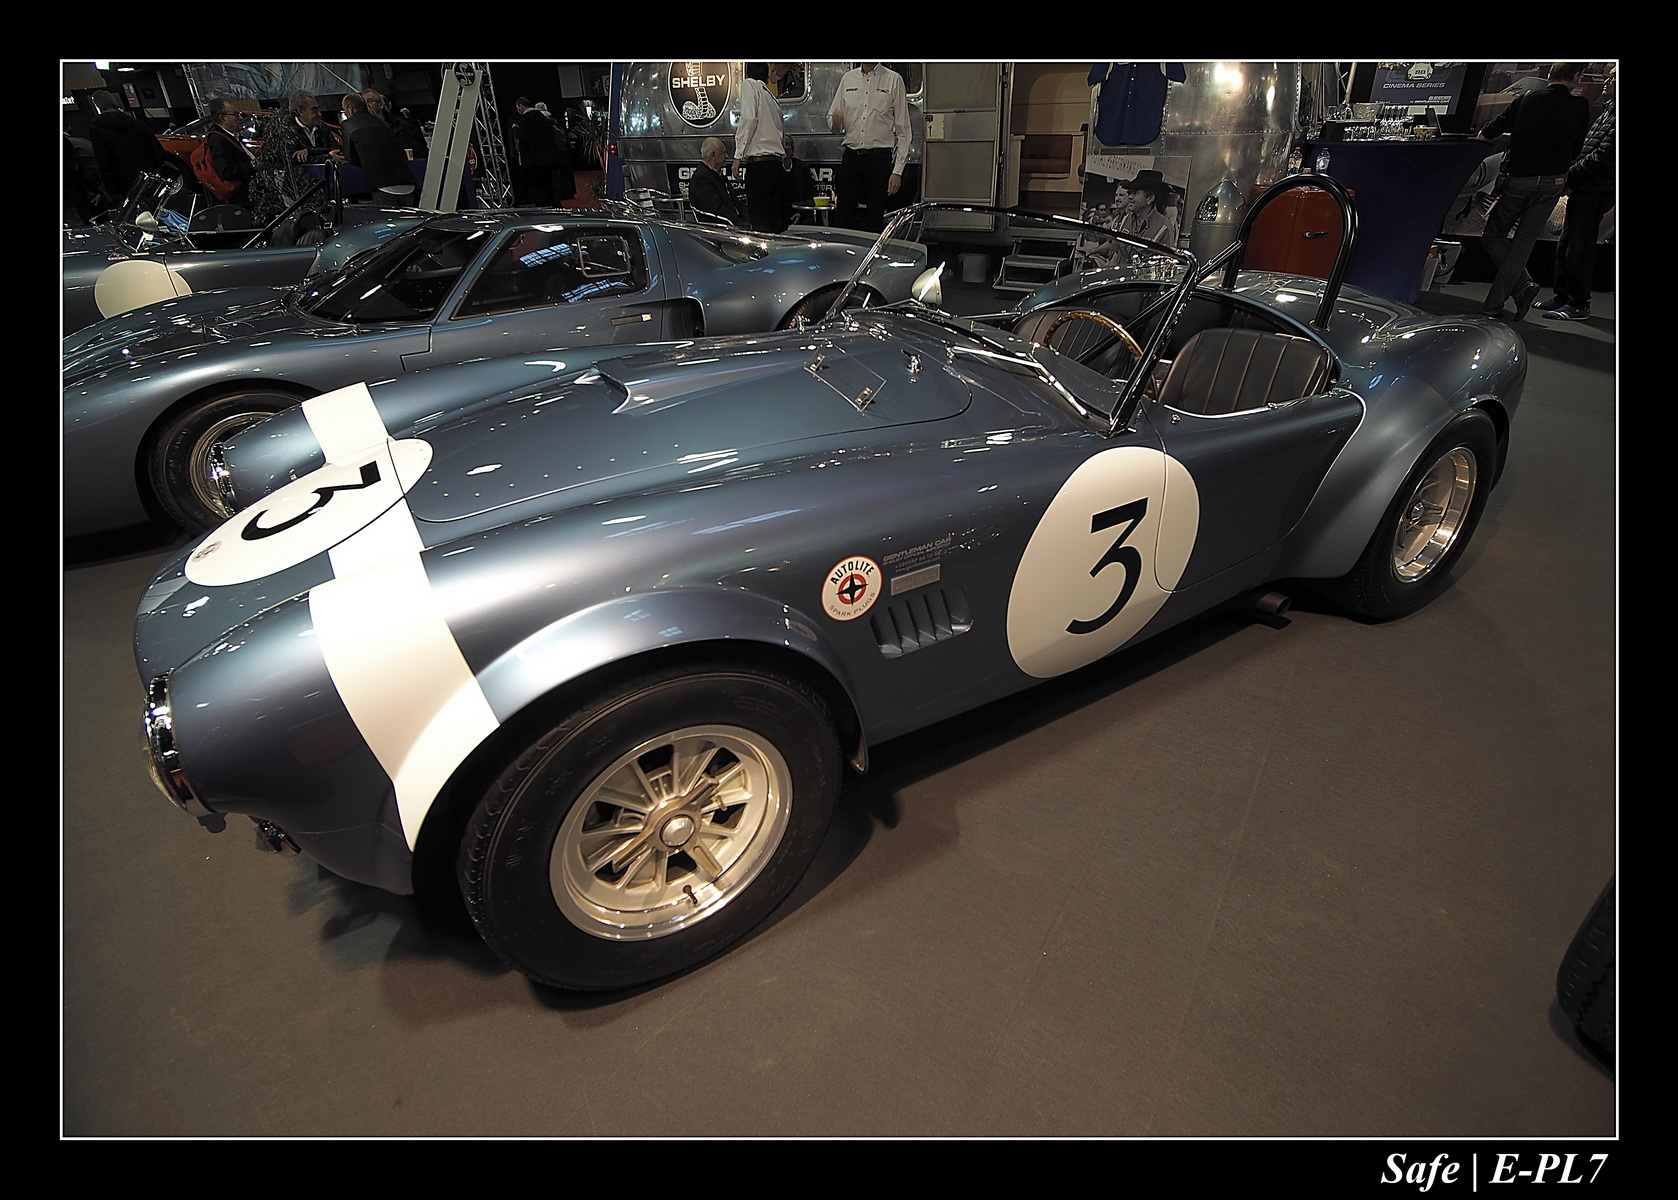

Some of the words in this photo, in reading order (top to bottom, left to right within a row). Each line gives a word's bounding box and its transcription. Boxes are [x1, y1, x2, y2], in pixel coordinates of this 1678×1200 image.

[672, 74, 725, 88] SHELBY
[241, 461, 381, 541] 3
[883, 542, 934, 561] GENTLEMAN
[934, 536, 952, 547] CAR
[830, 560, 875, 585] AUTOLITE
[1065, 497, 1148, 634] 3
[829, 605, 852, 616] SPARK
[853, 592, 876, 614] PLUGS
